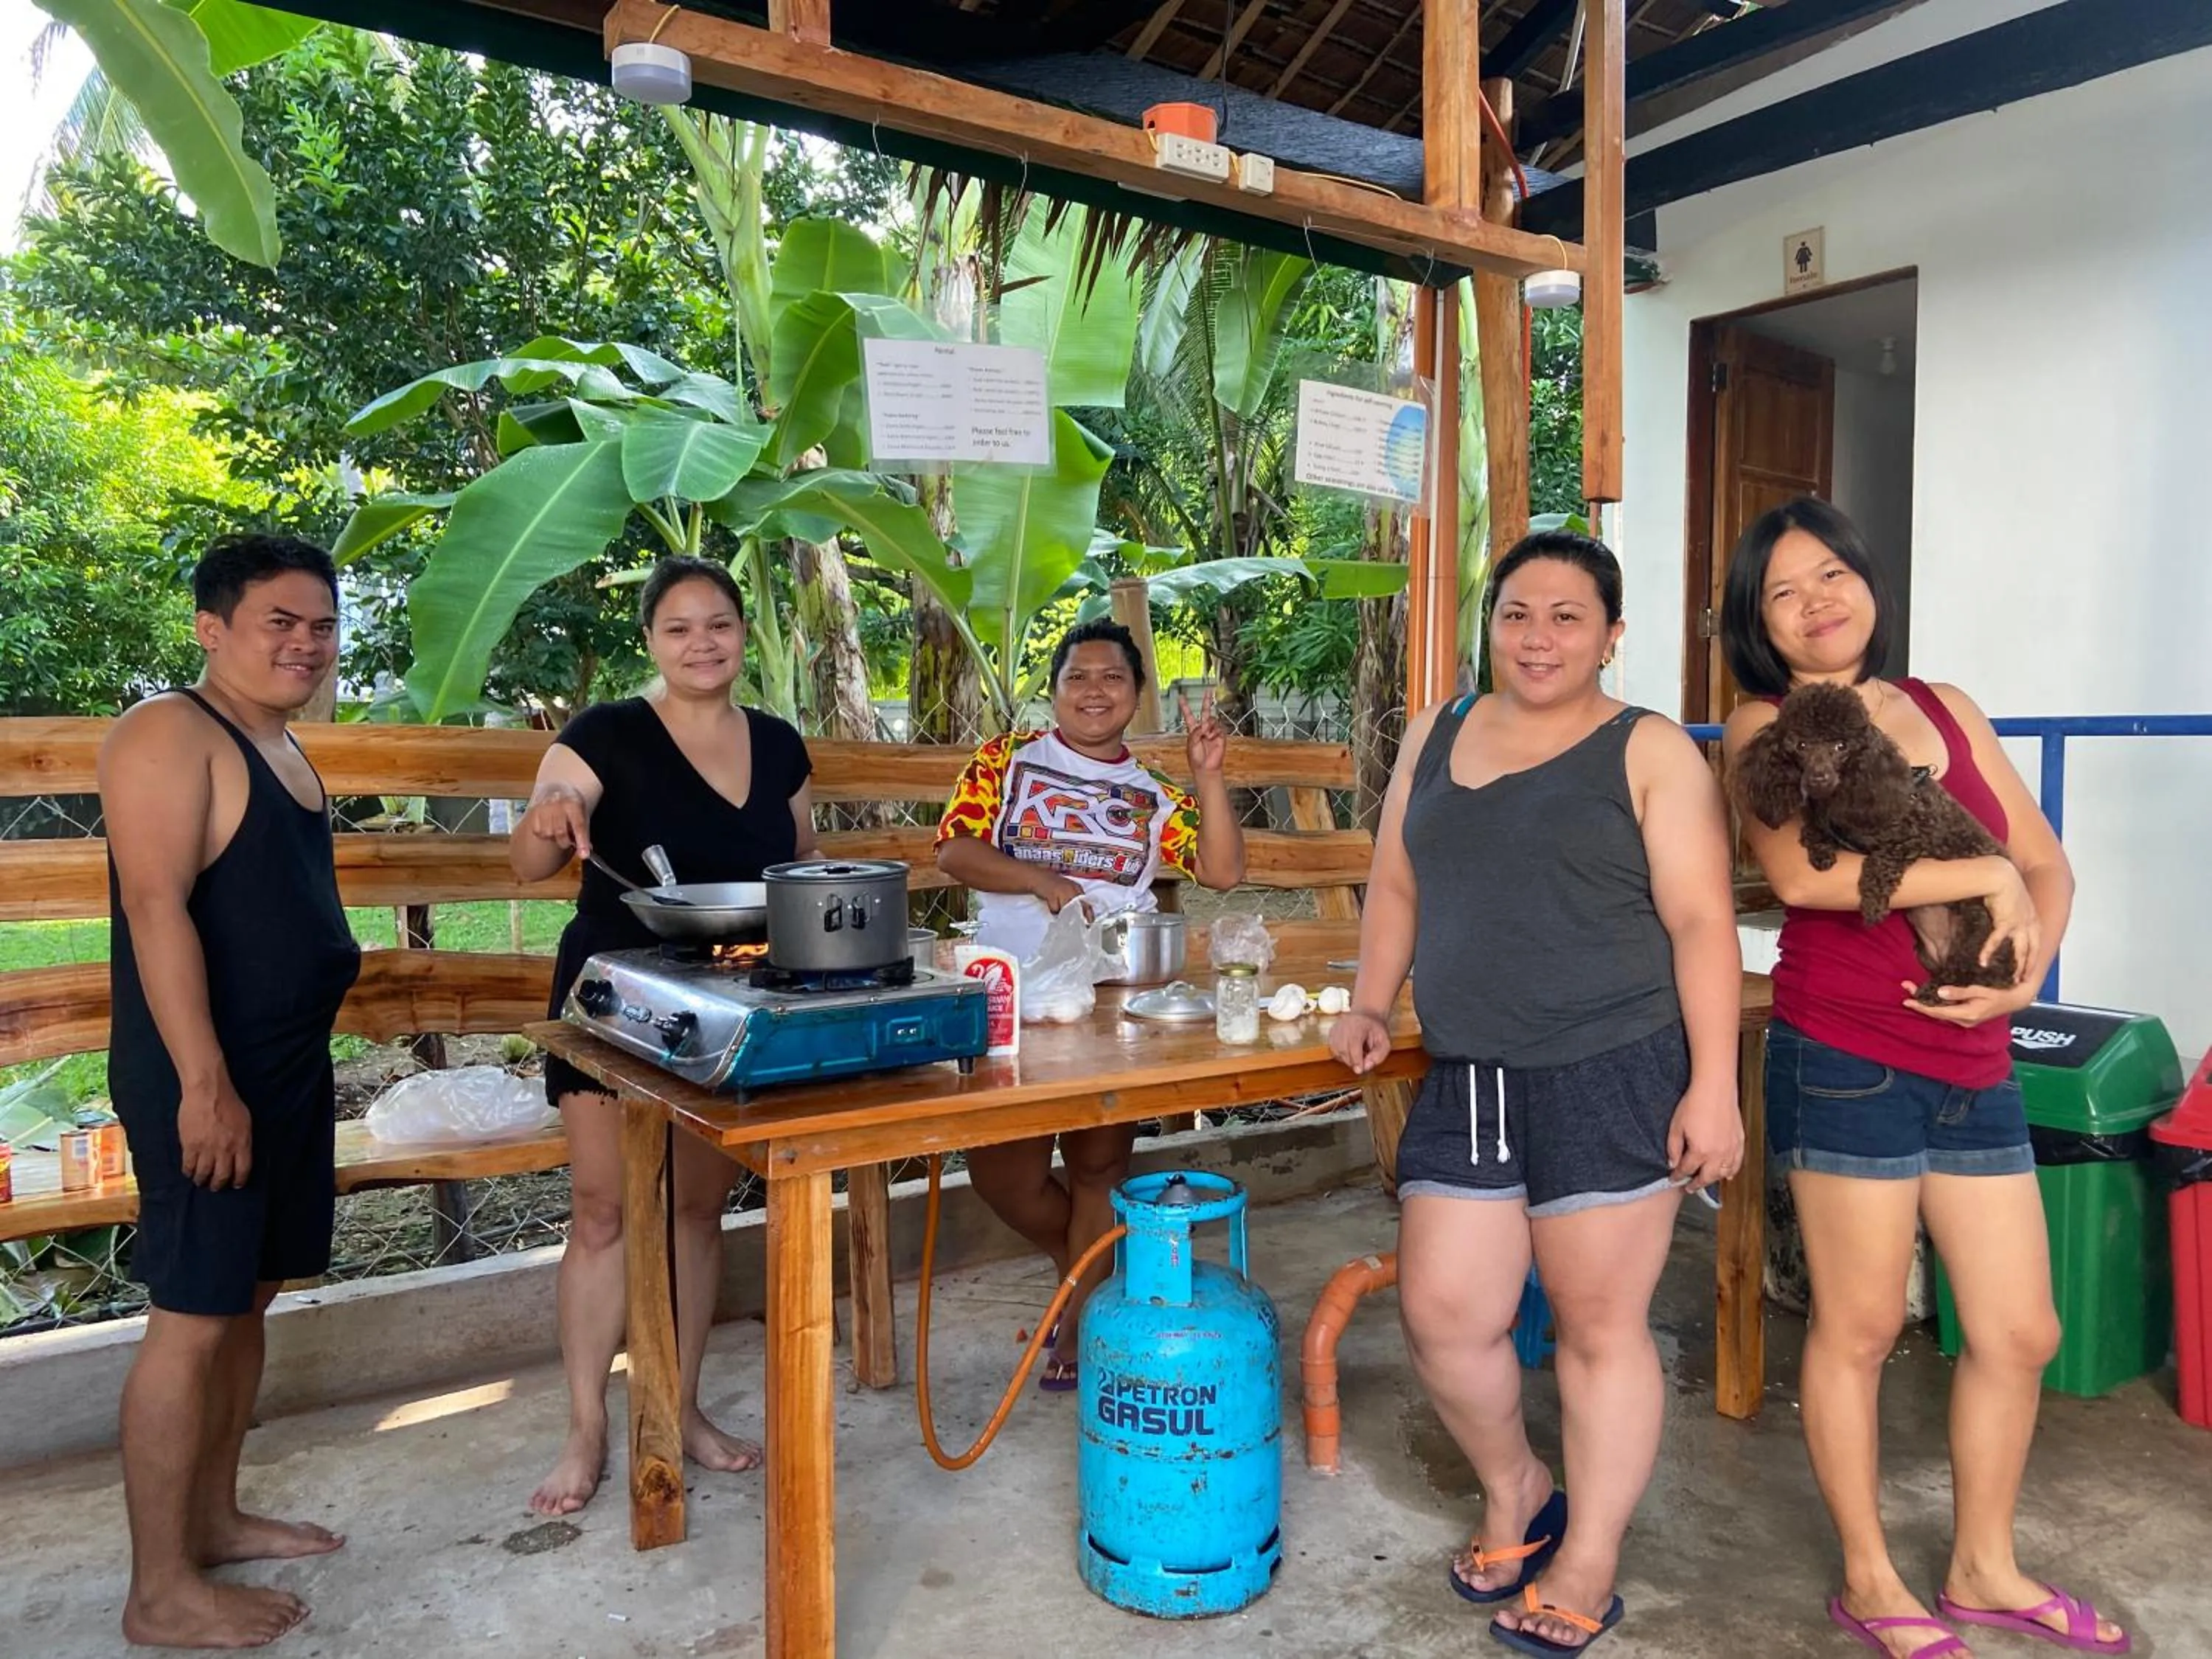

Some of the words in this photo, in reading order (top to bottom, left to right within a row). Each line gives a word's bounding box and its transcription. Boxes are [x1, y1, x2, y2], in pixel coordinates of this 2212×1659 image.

[971, 425, 992, 436] Please
[2011, 1026, 2076, 1046] PUSH
[1118, 1383, 1217, 1406] PETRON
[1098, 1396, 1214, 1436] GASUL
